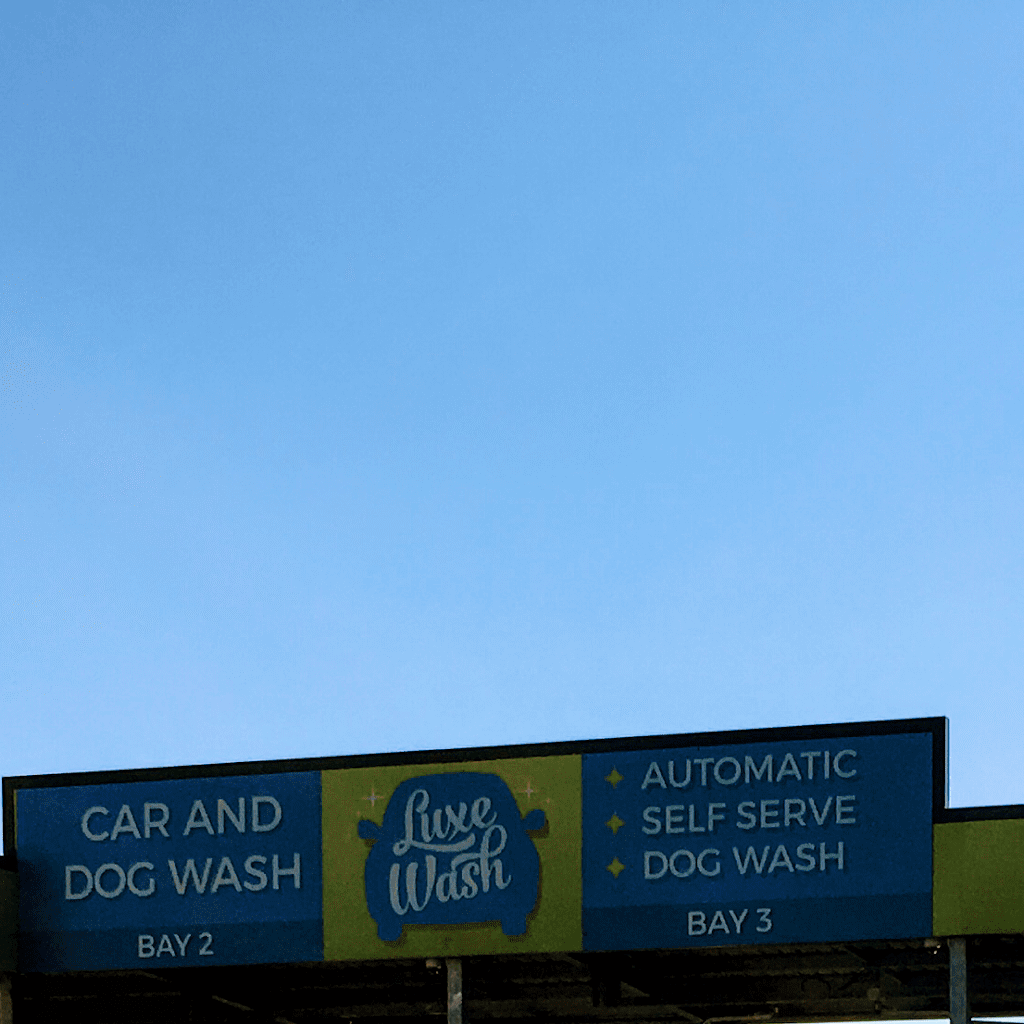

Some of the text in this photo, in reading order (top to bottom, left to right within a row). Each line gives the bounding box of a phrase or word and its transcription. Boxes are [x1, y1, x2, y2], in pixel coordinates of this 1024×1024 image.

[641, 749, 857, 789] AUTOMATIC
[81, 795, 282, 841] CAR AND
[393, 789, 498, 856] Luxe
[642, 795, 856, 834] SELF SERVE
[65, 852, 301, 900] DOG WASH
[389, 824, 512, 915] Wash
[644, 841, 844, 879] DOG WASH
[687, 908, 773, 936] BAY 3
[138, 932, 214, 958] BAY 2
